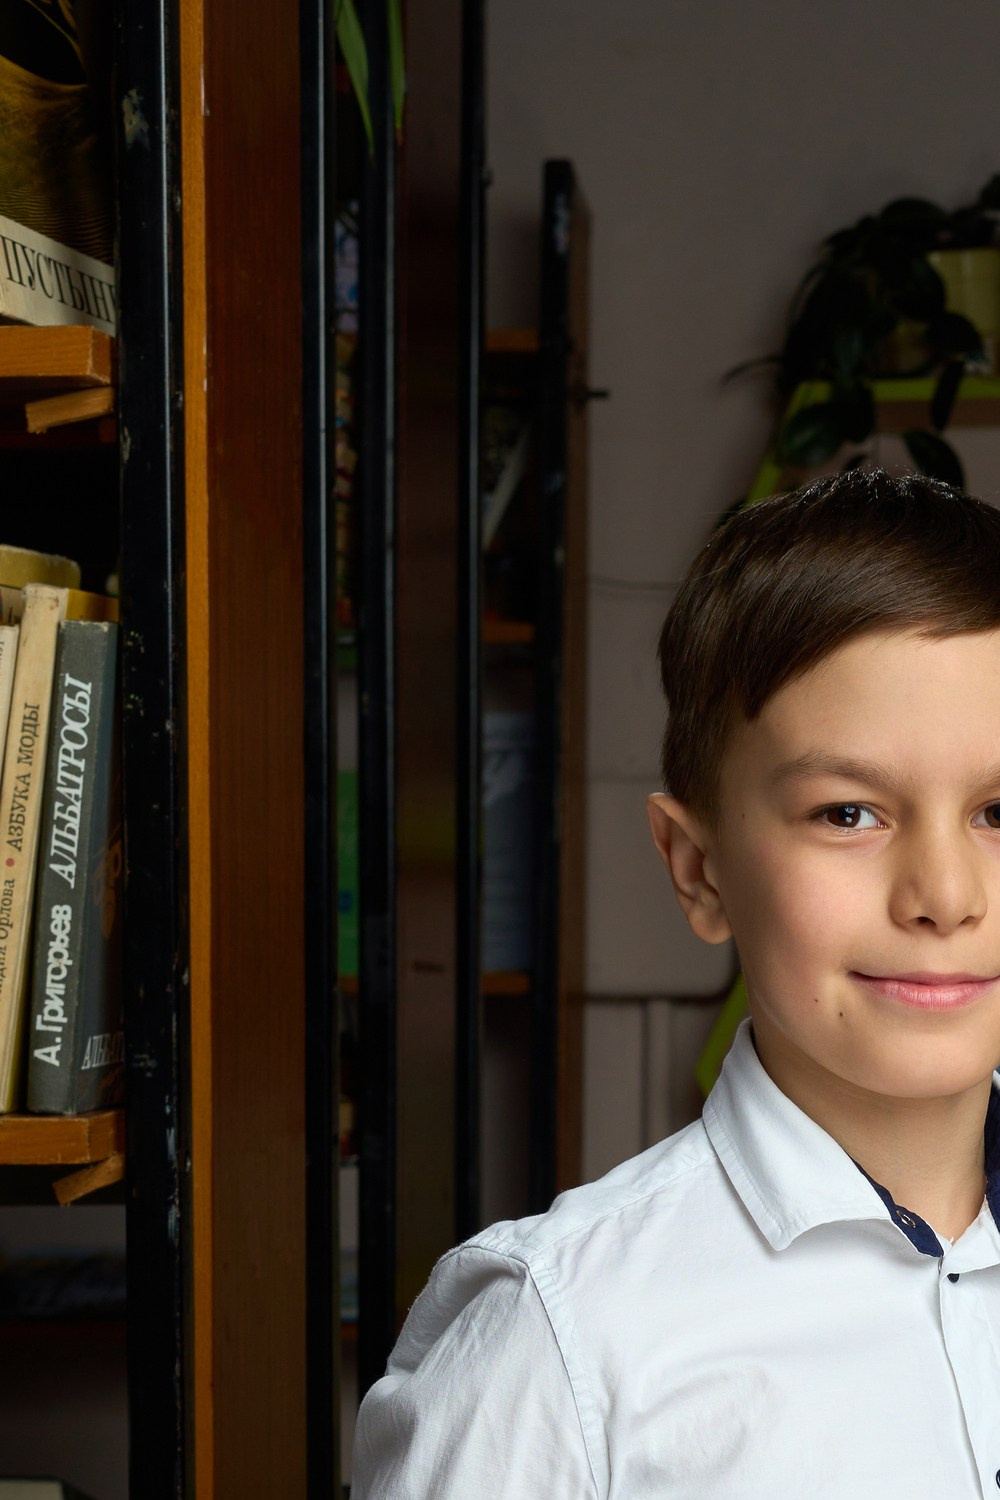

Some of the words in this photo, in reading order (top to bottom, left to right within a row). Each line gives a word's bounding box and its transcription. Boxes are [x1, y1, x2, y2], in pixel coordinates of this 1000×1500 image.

[16, 702, 41, 764] МОДЫ
[6, 767, 32, 852] АЗБУКА
[48, 673, 92, 890] АЛЬБАТРОСЫ
[0, 878, 16, 940] Орлова
[35, 903, 73, 1033] Григорьев
[33, 1036, 63, 1068] А.
